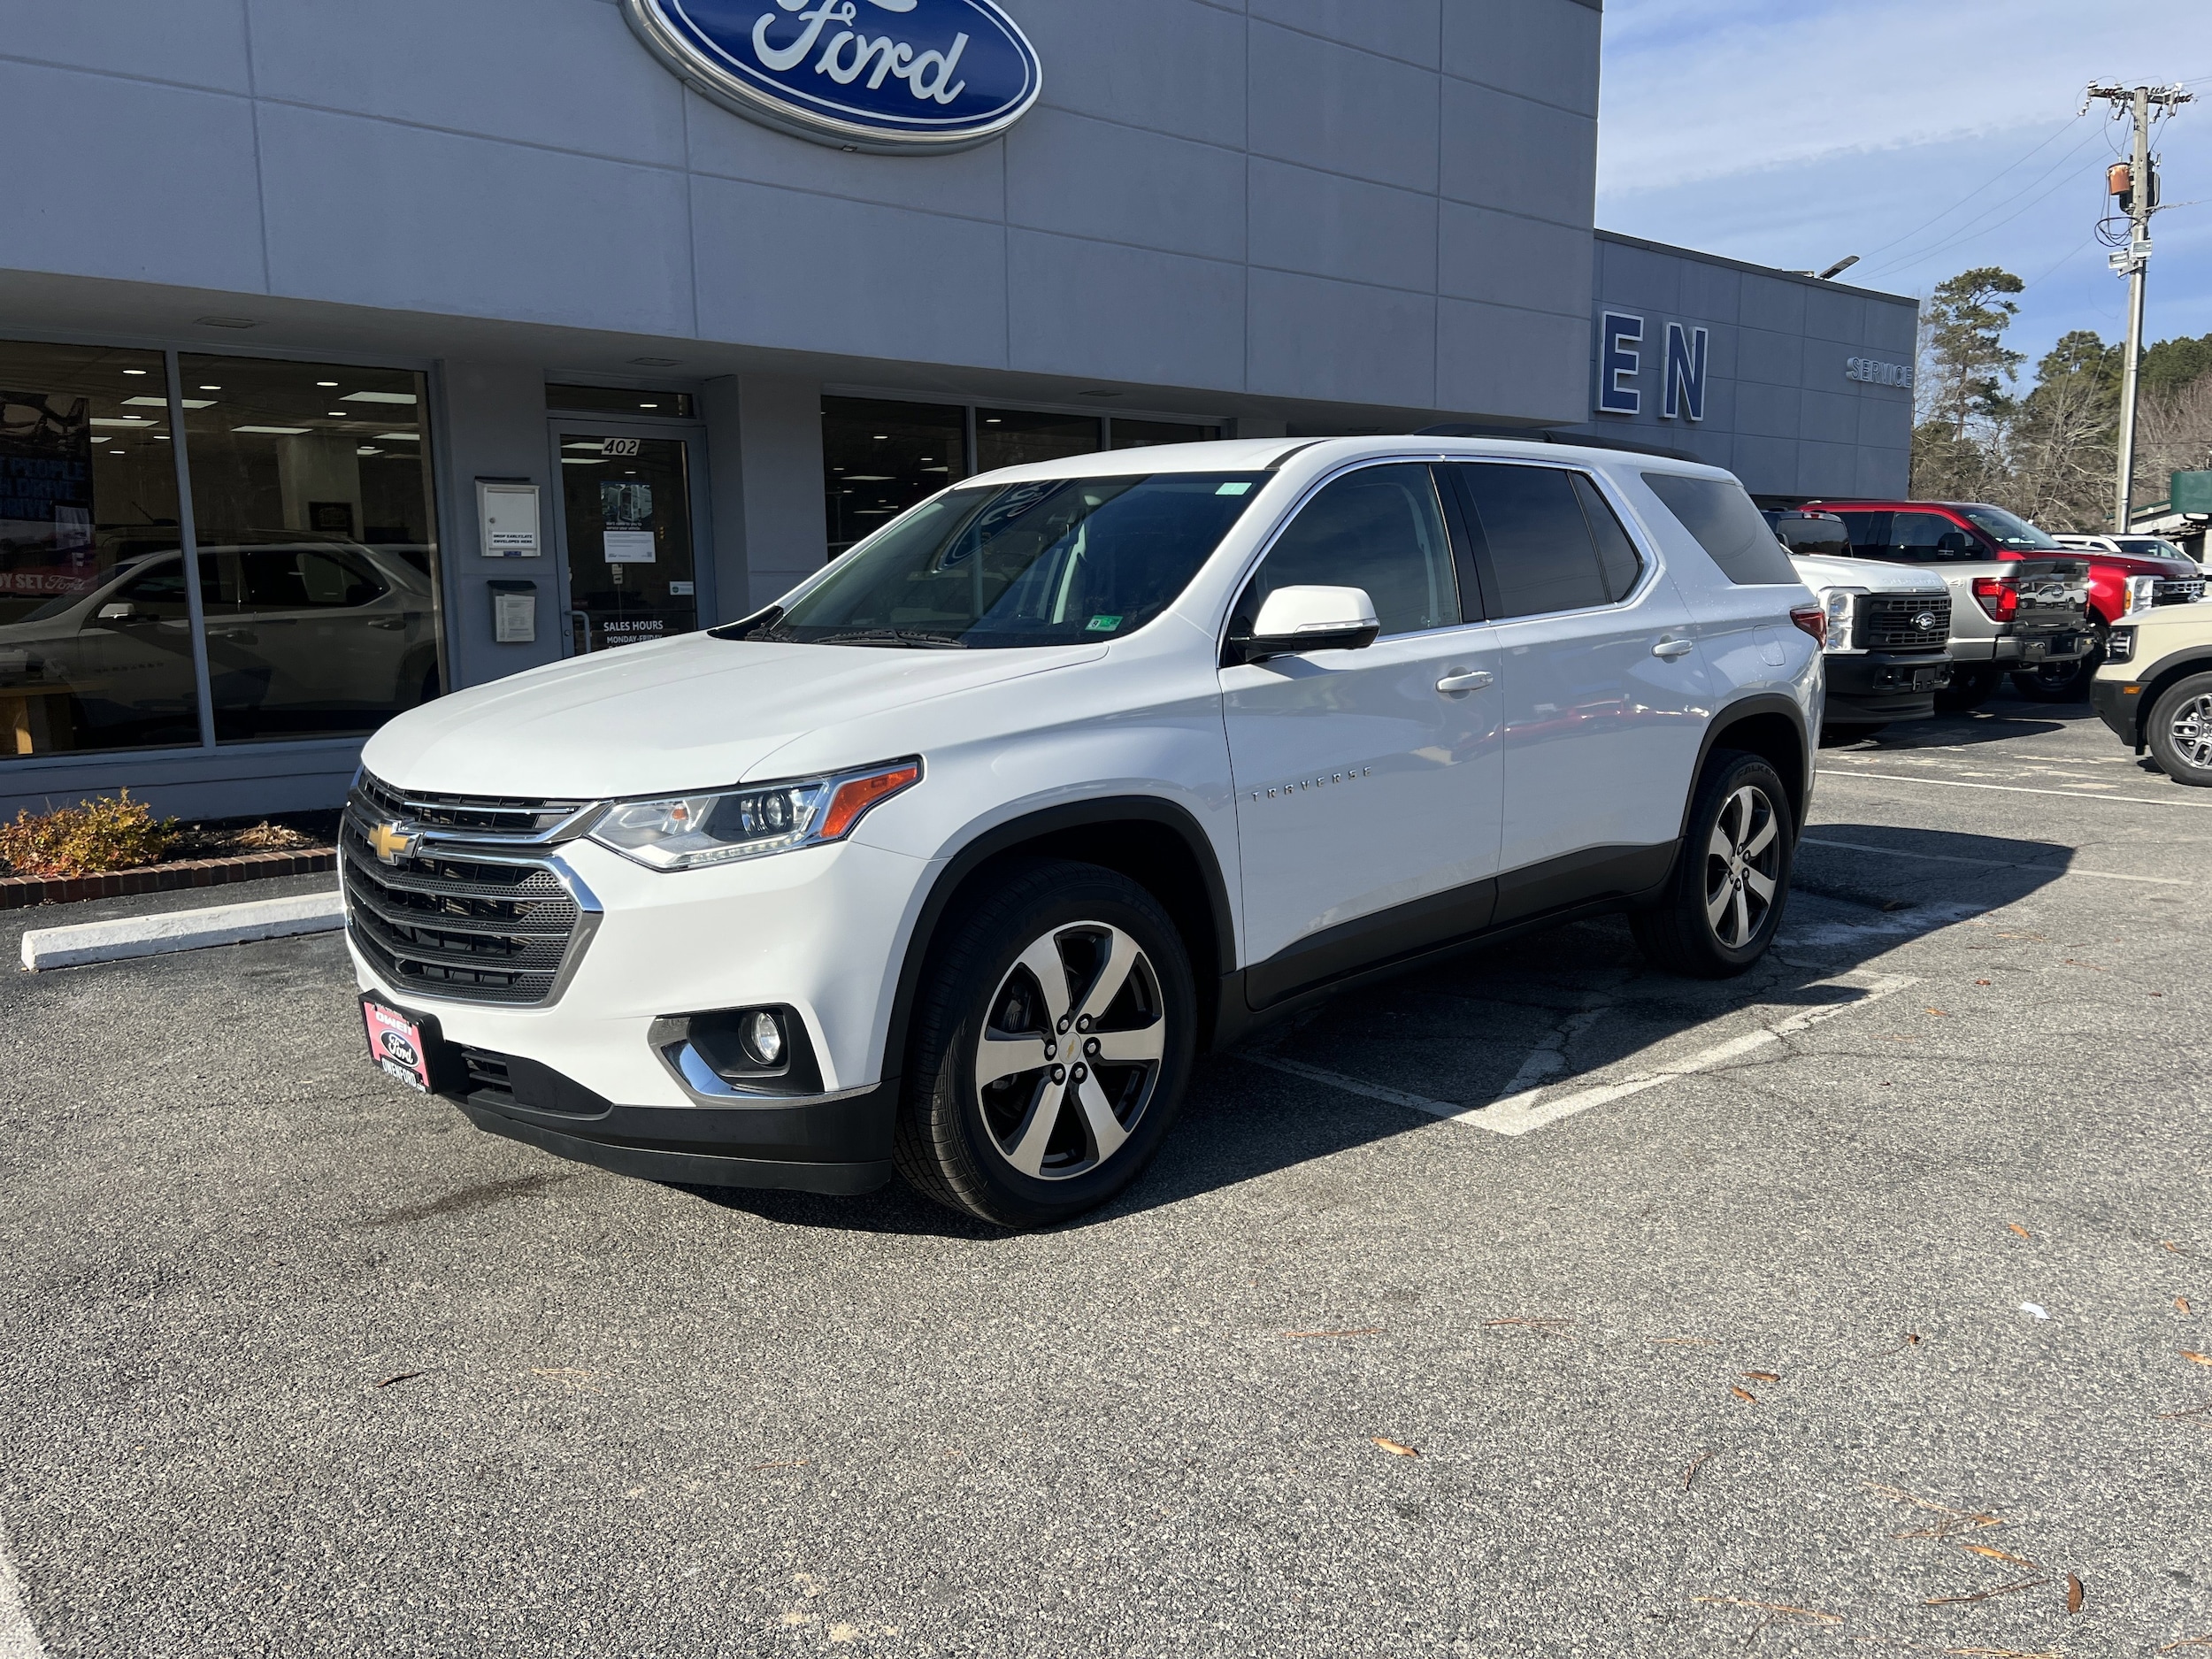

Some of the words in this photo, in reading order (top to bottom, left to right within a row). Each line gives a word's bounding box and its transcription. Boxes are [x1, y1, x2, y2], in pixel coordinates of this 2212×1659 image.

[751, 0, 970, 105] Ford
[1848, 357, 1913, 388] SERVICE
[603, 440, 637, 456] 402
[15, 573, 43, 589] SET
[45, 574, 86, 591] Ford
[603, 621, 630, 632] SALES
[633, 620, 664, 631] HOURS
[1251, 766, 1372, 803] TRAVERSE
[388, 1033, 413, 1064] Ford
